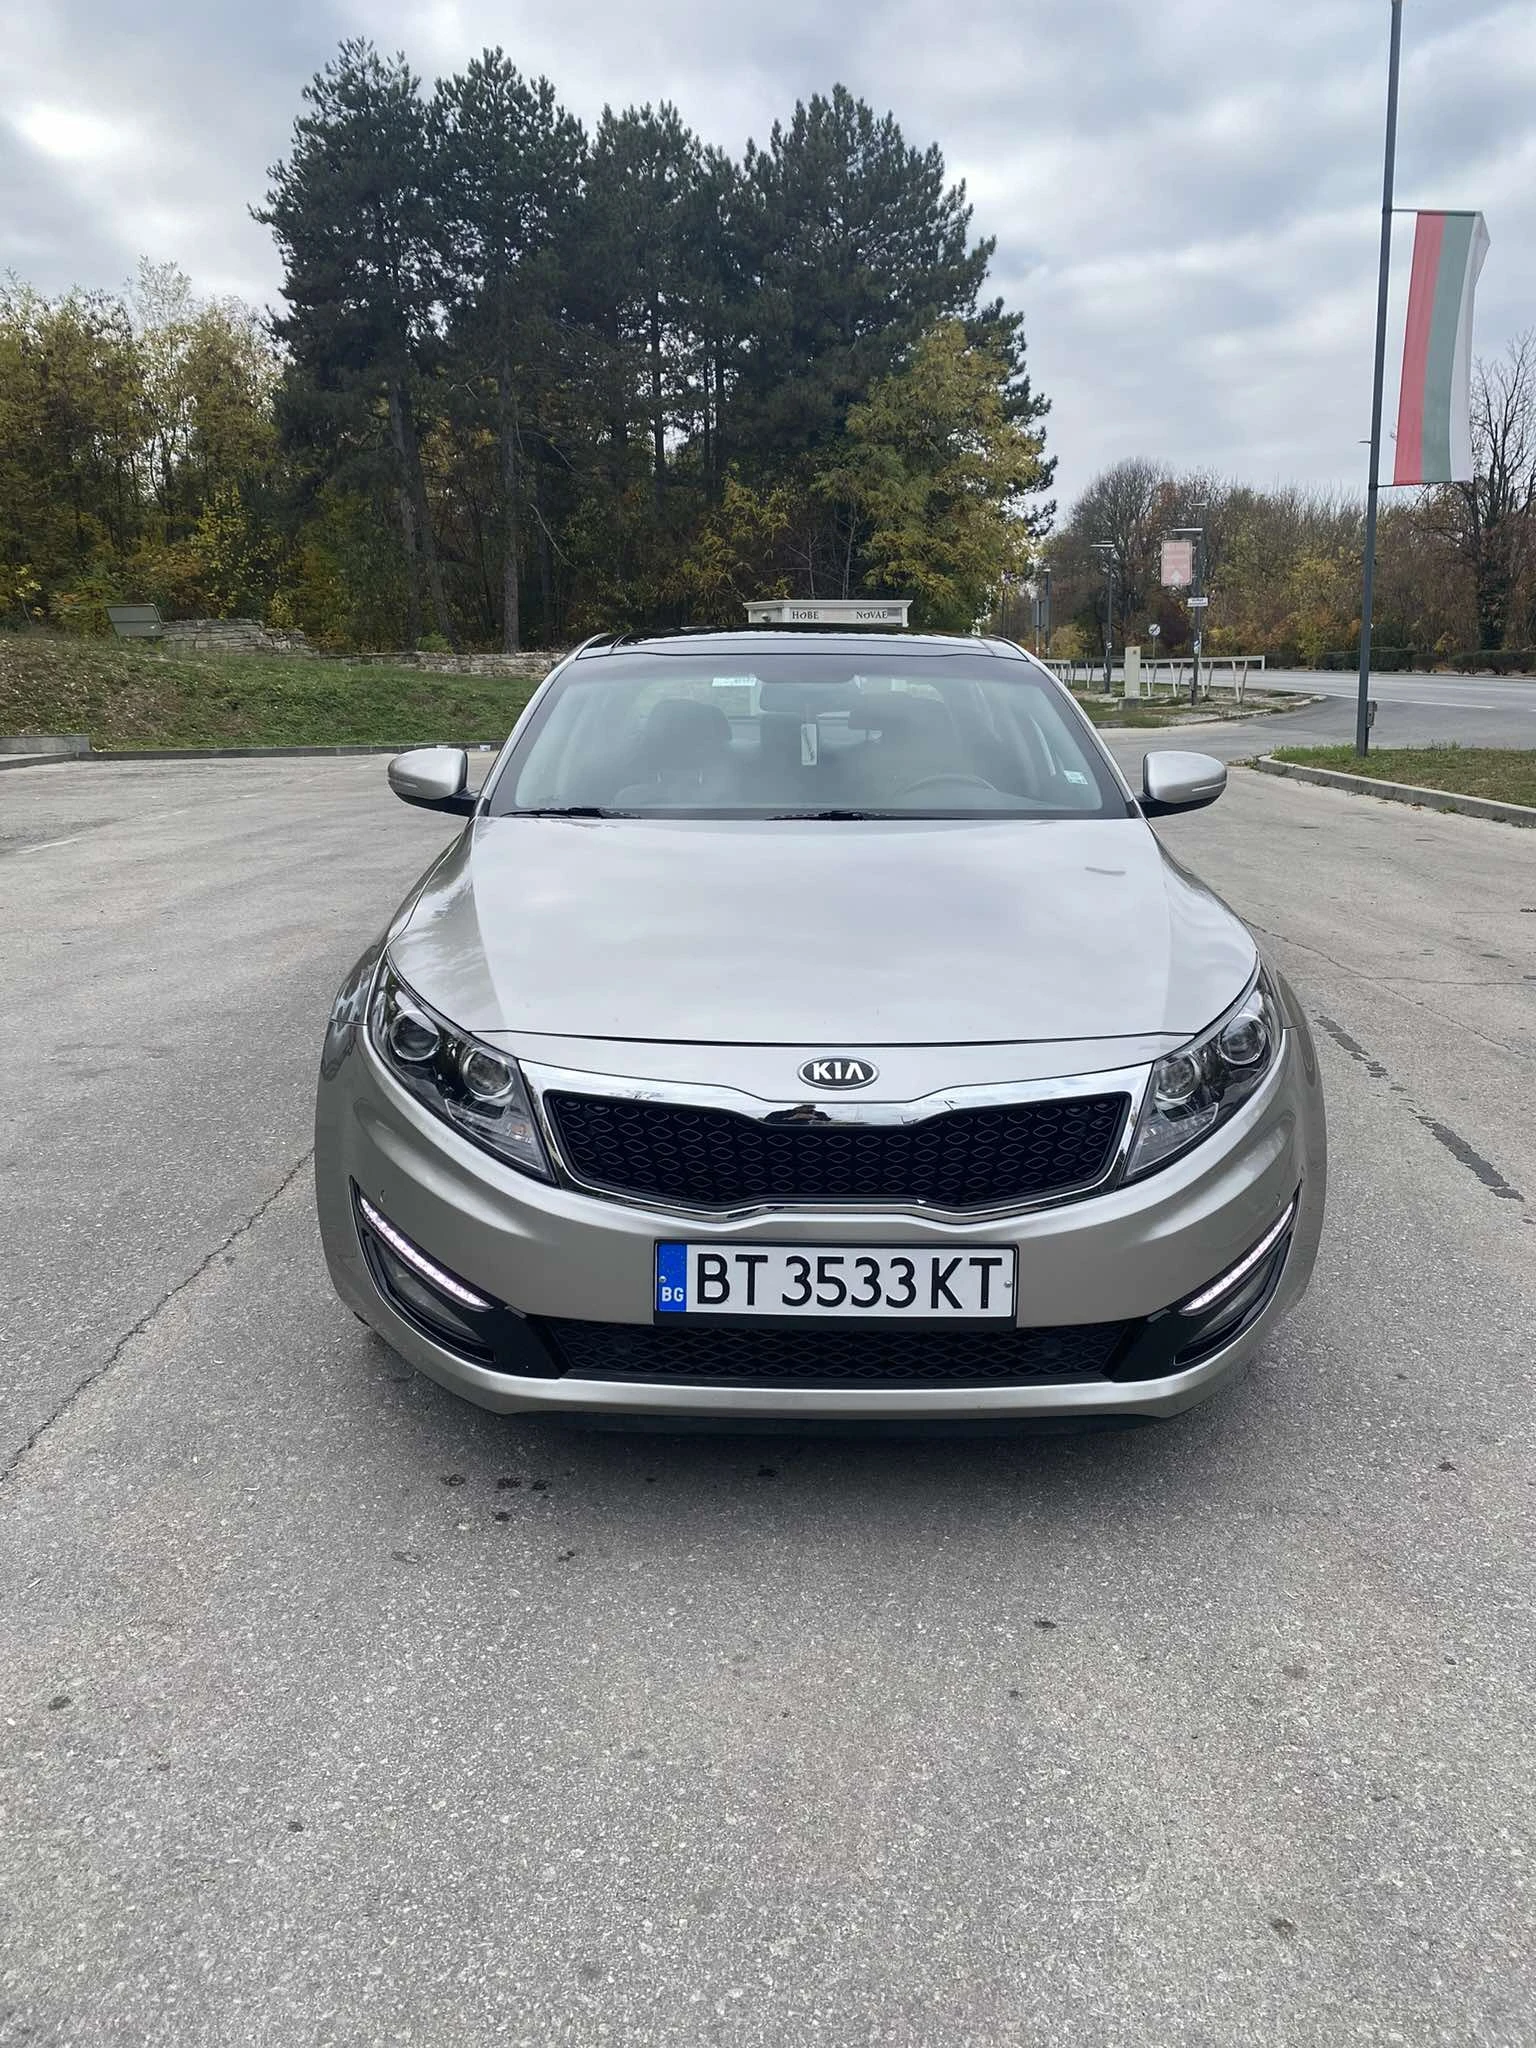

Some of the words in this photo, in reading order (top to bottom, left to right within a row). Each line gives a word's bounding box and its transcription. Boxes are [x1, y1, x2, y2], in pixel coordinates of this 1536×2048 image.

[812, 1062, 865, 1080] KIA
[697, 1253, 768, 1306] BT
[782, 1256, 917, 1309] 3533
[931, 1257, 1003, 1309] KT
[661, 1287, 685, 1303] BG
